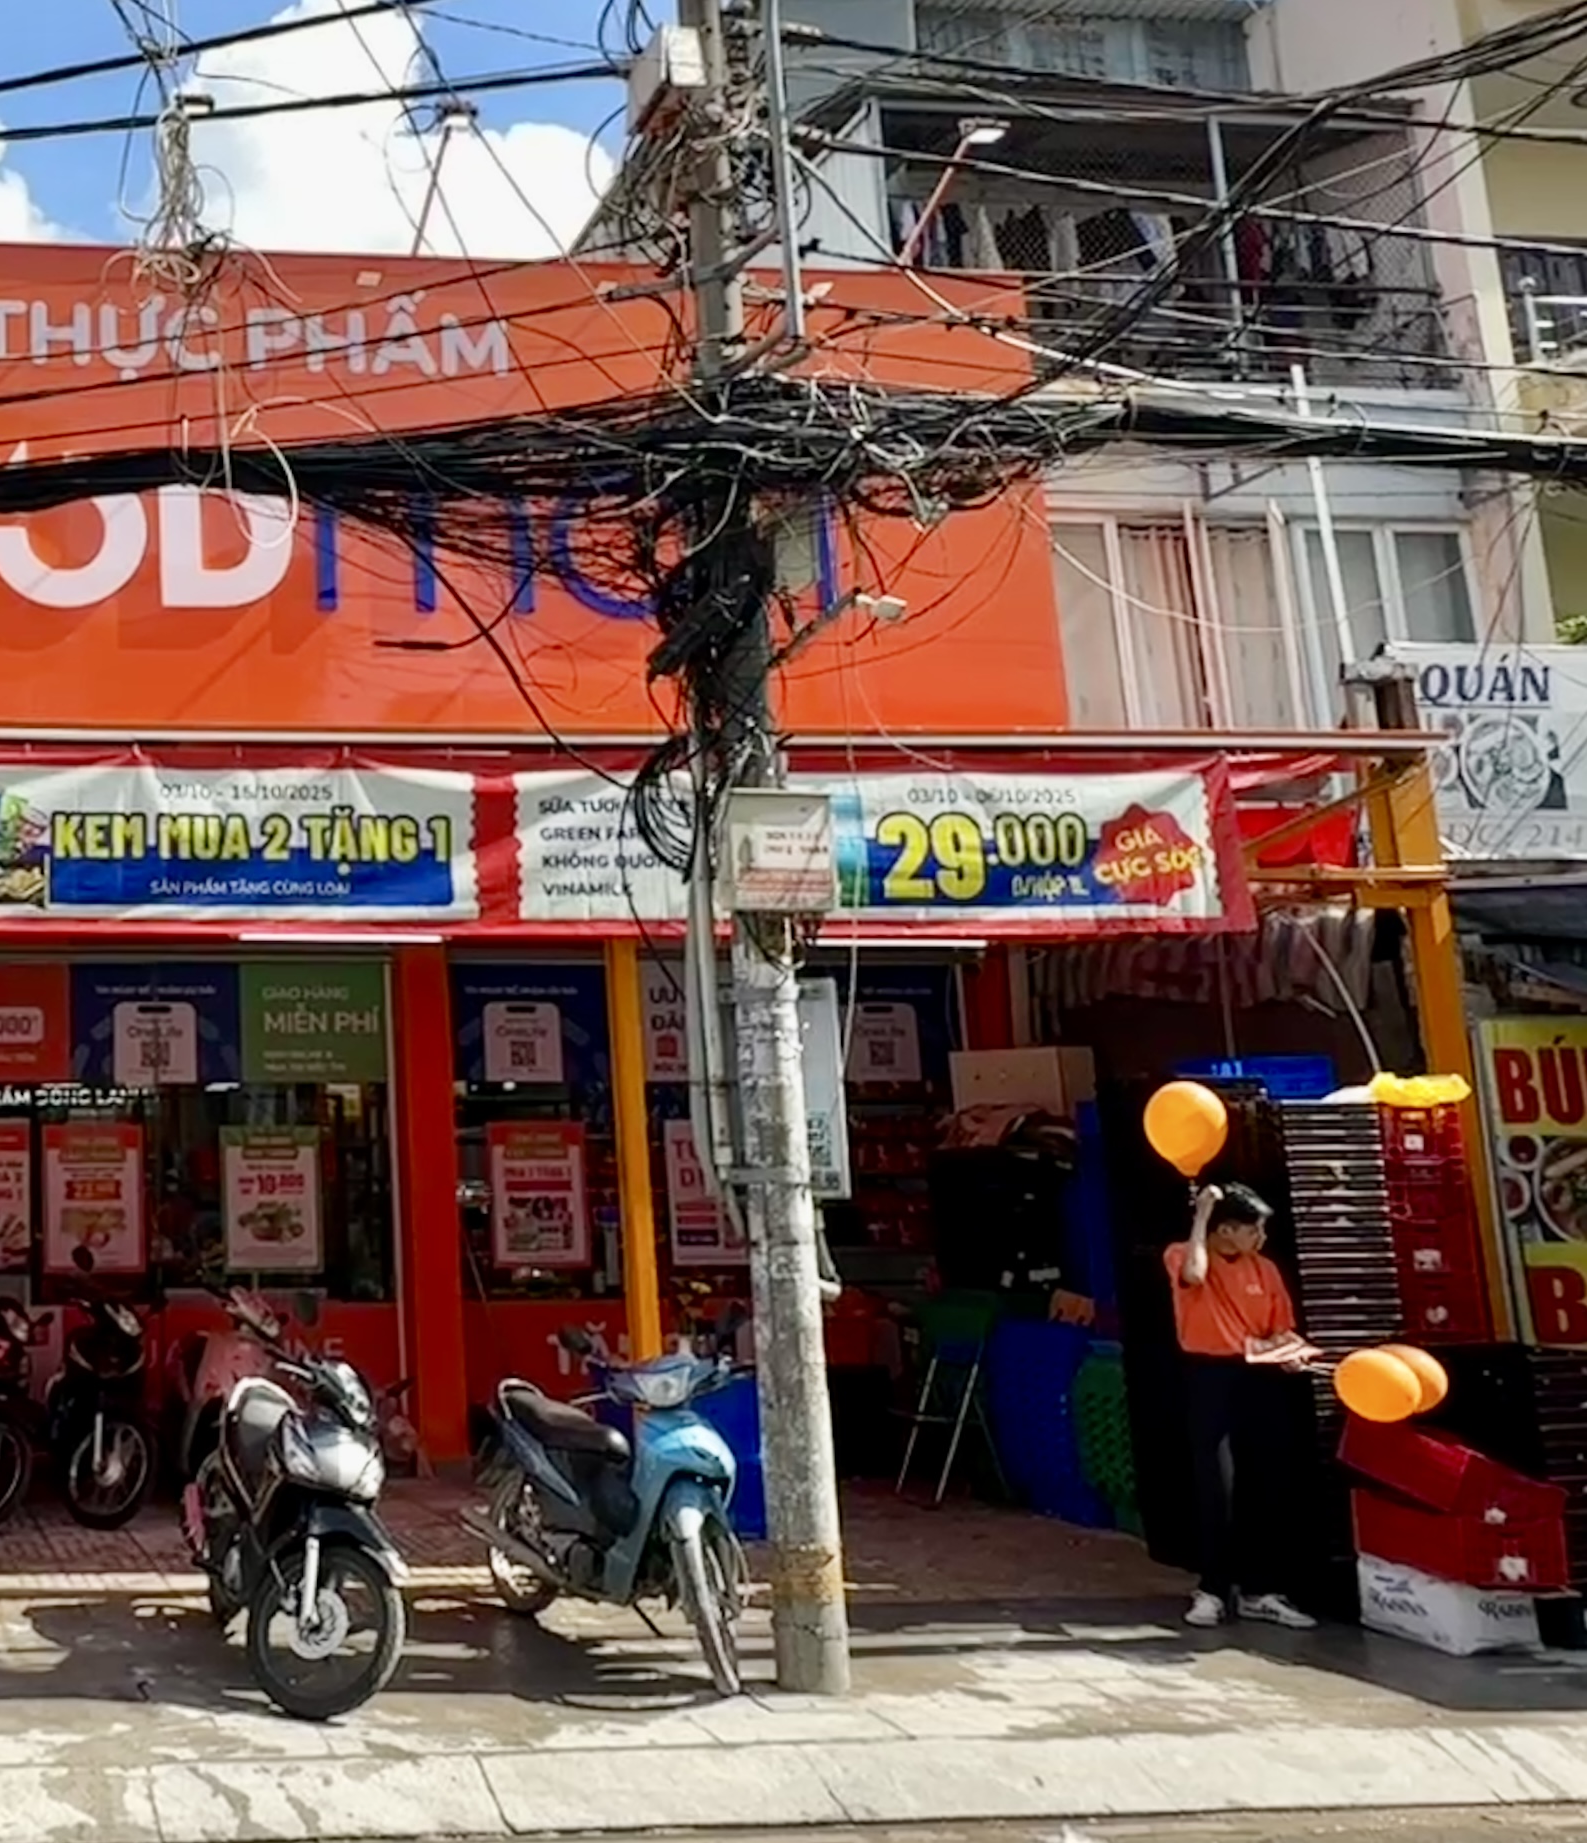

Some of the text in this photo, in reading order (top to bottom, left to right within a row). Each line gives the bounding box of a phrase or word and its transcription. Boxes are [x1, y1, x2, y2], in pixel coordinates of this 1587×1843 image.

[1419, 653, 1551, 705] QUÁN
[907, 788, 959, 805] 03/10
[49, 803, 453, 878] KEM MUA 2 TẶNG 1
[540, 827, 601, 842] GREEN
[1114, 820, 1165, 853] GIÁ
[541, 849, 610, 869] KHÔNG
[875, 811, 1088, 902] 29.000
[1093, 856, 1153, 886] CỰC
[263, 1002, 380, 1035] MIỄN PHÍ
[1493, 1035, 1587, 1126] BÚ
